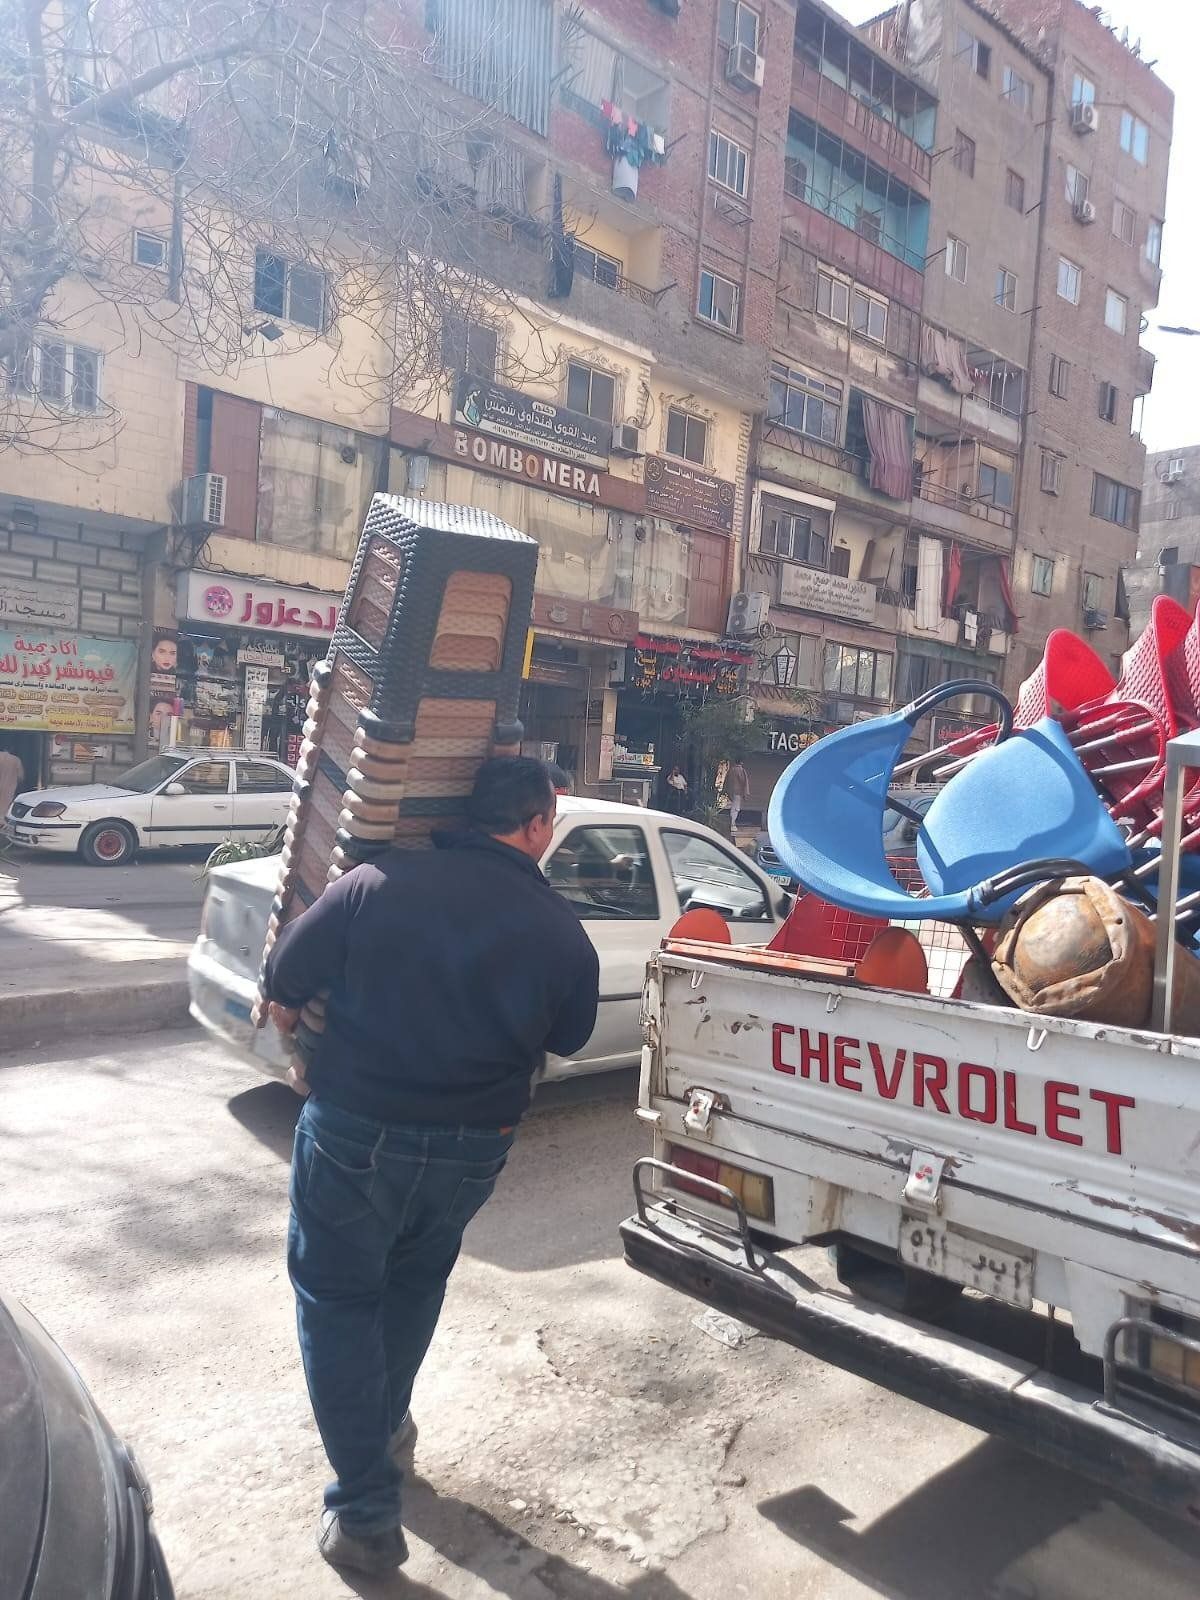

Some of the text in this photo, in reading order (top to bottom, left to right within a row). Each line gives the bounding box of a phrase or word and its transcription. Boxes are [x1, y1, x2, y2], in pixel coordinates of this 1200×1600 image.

[454, 430, 602, 498] BOMBONERA
[580, 431, 598, 445] عبد
[771, 1022, 1136, 1155] CHEVROLET
